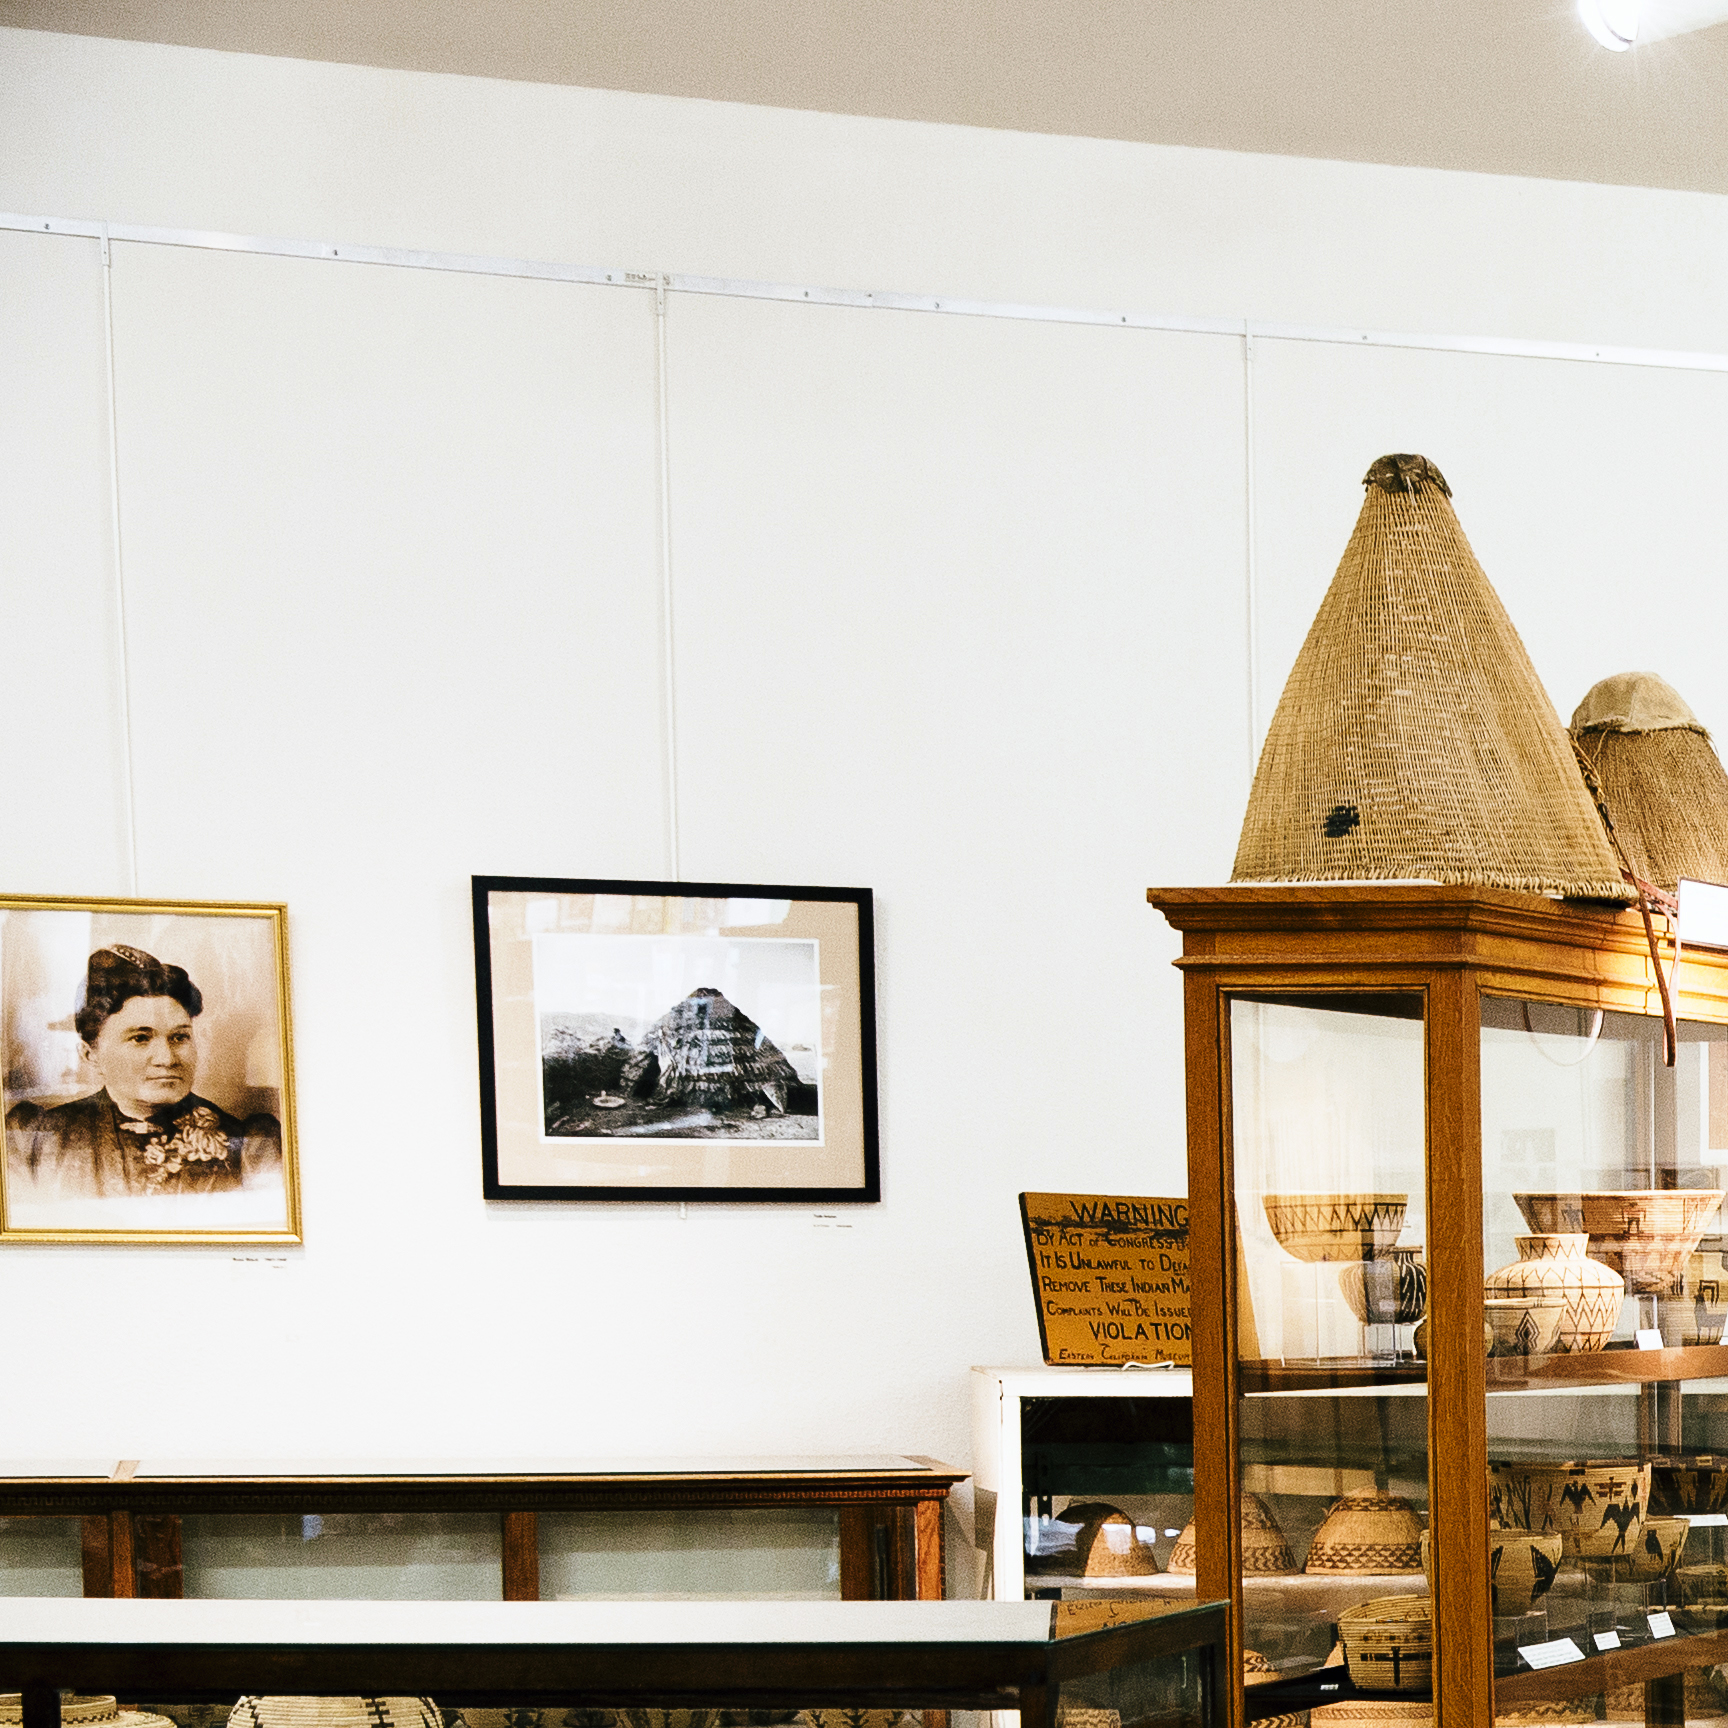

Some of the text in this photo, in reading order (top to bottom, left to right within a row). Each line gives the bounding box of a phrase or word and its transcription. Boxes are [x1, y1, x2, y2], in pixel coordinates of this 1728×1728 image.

[1069, 1200, 1189, 1227] WARNING
[1069, 1251, 1133, 1271] UNLAWFUL
[1041, 1276, 1091, 1293] REMOVE
[1095, 1275, 1129, 1294] THESE
